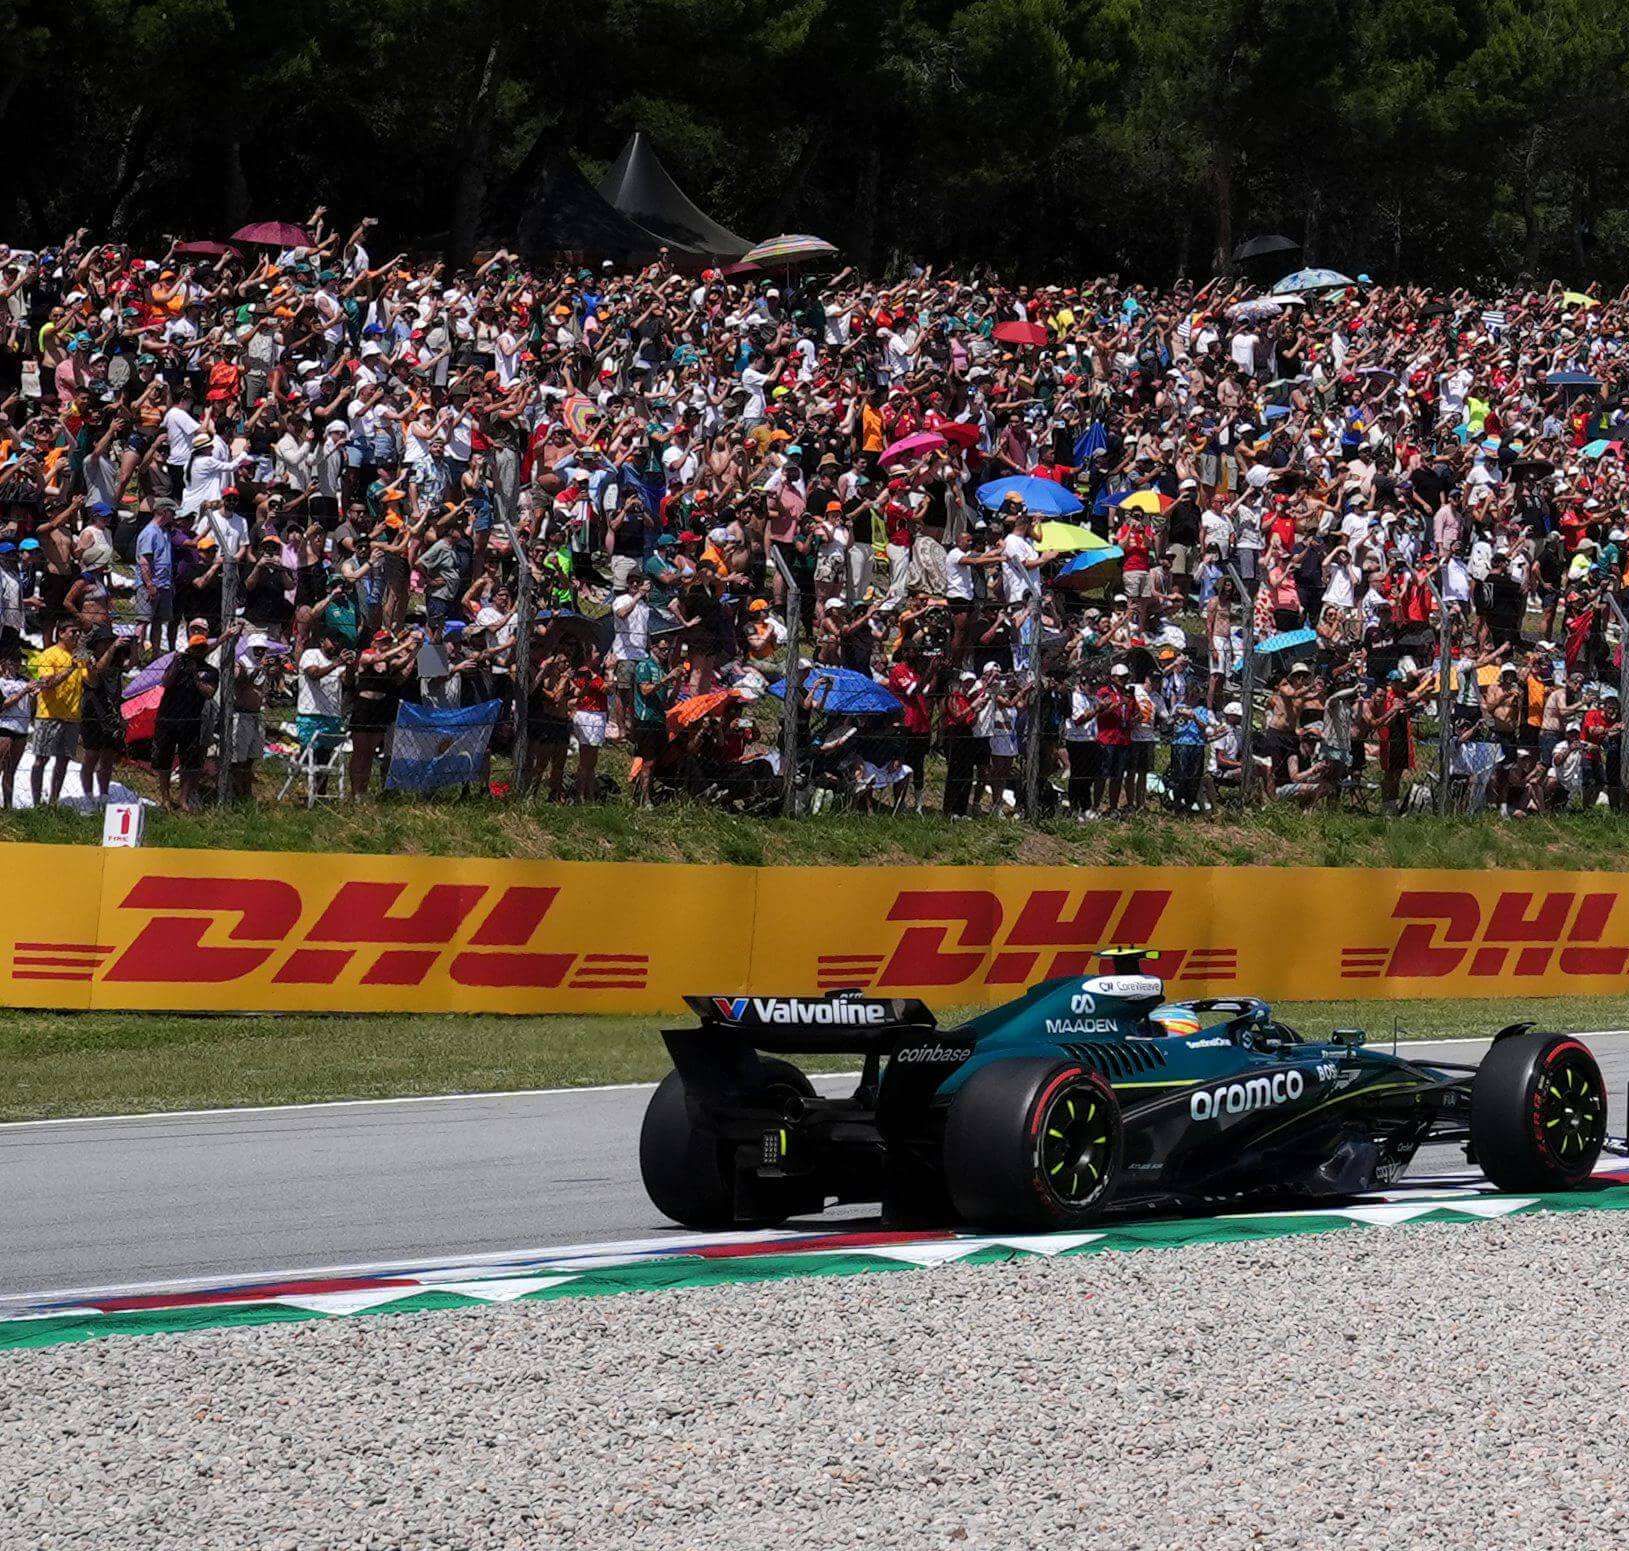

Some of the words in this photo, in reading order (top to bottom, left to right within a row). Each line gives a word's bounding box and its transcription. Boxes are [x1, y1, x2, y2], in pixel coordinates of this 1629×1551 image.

[102, 875, 579, 989] DHL
[877, 890, 1187, 986] DHL
[753, 998, 885, 1024] Valvoline
[1046, 1018, 1119, 1034] MAADEN
[897, 1044, 971, 1063] coinbase
[1190, 1070, 1303, 1121] aramco
